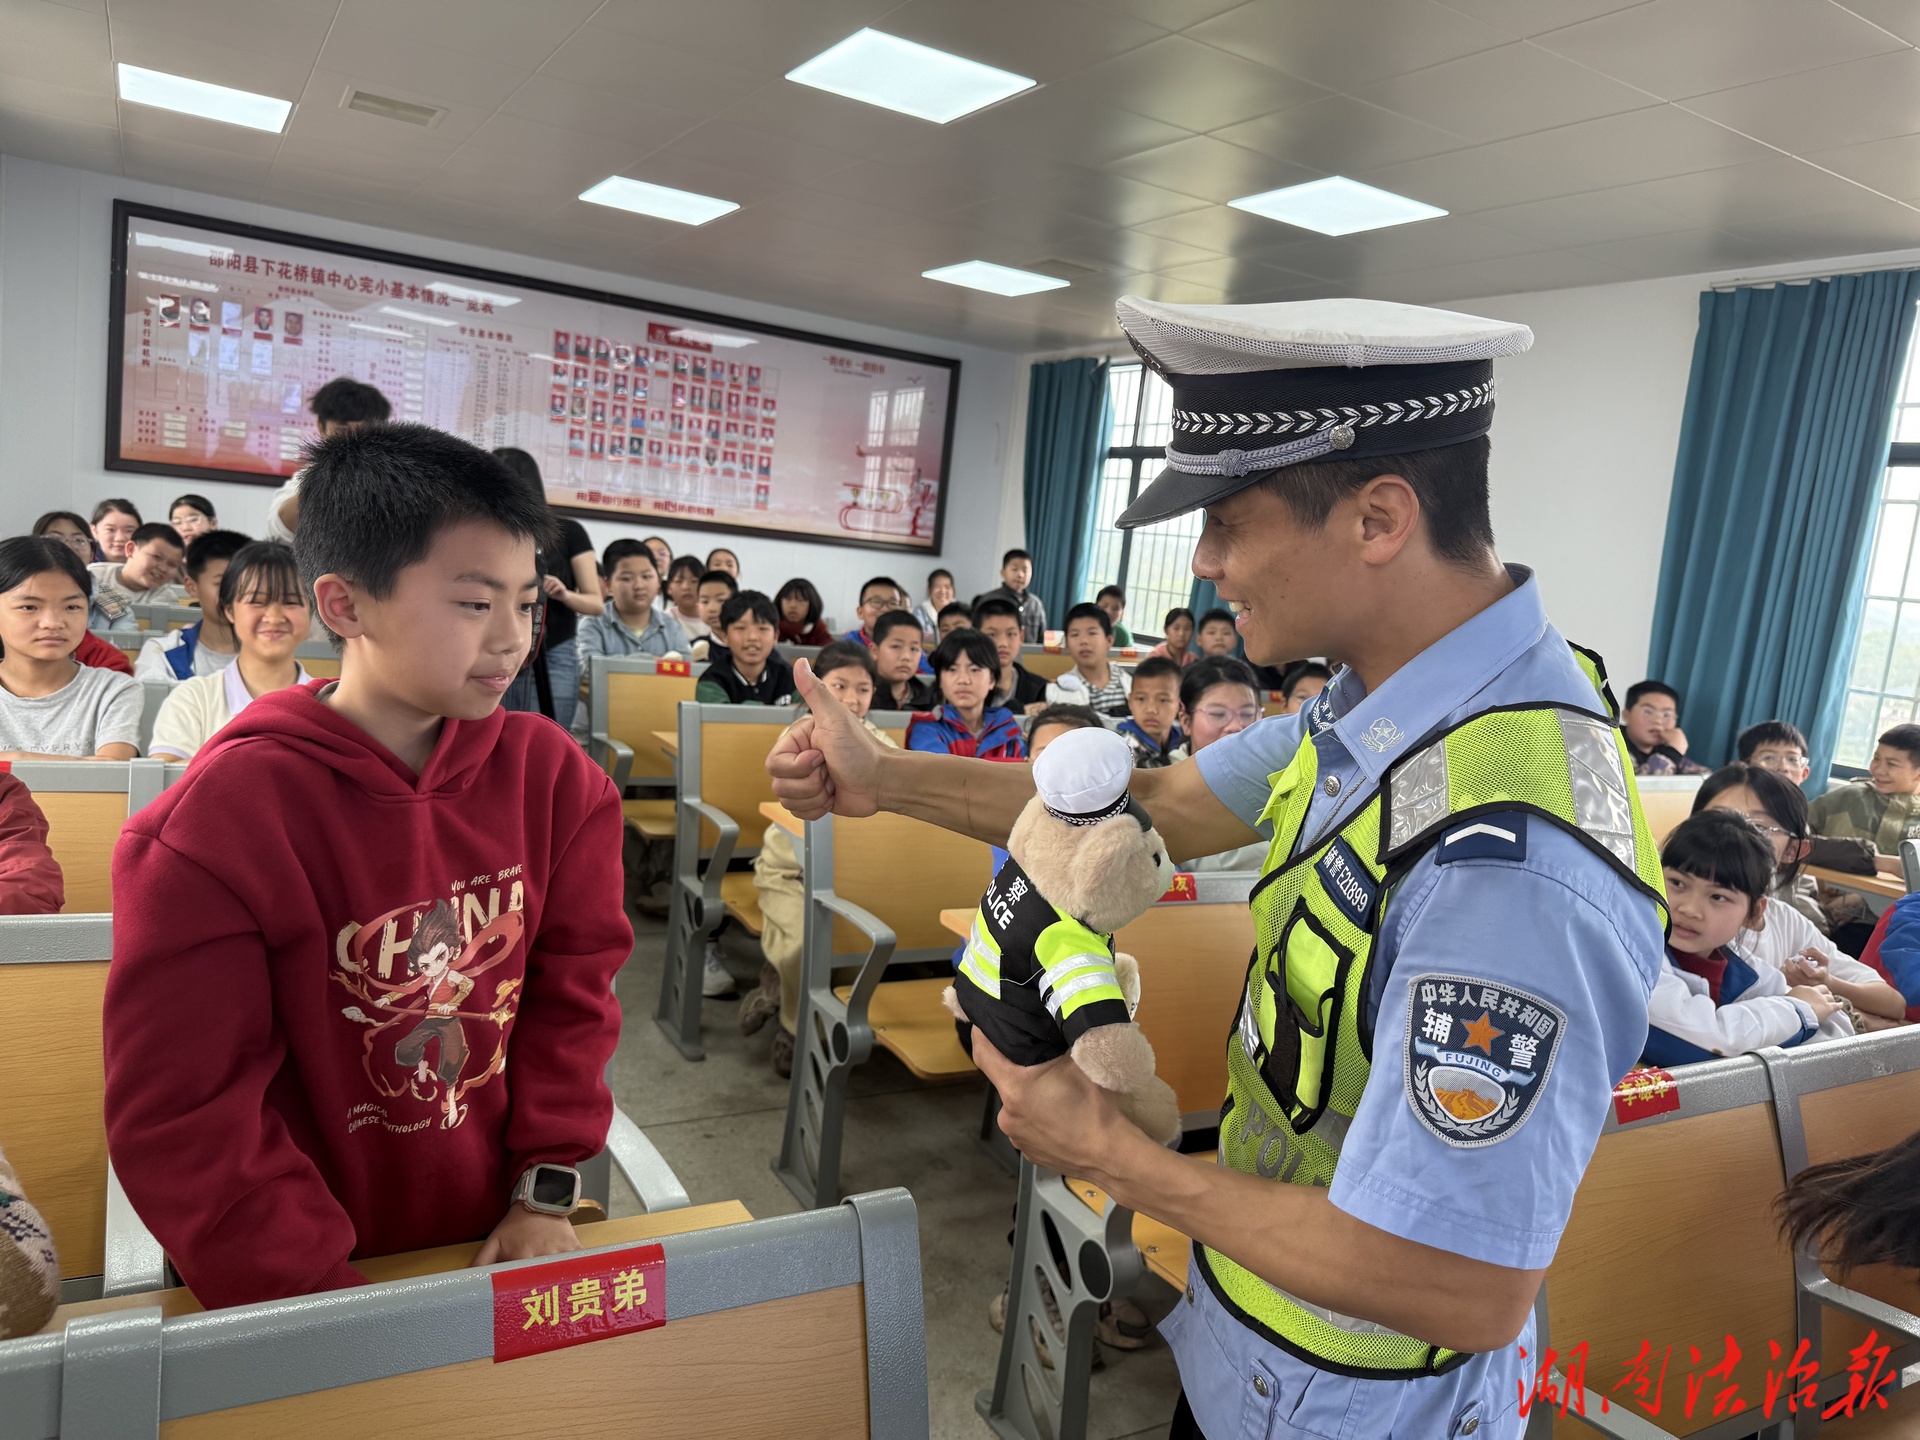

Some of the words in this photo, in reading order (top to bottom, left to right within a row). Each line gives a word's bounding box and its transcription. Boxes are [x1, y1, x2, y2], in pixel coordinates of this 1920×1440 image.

[209, 249, 495, 314] 邵阳县下花桥镇中心完小基本情况一览表
[451, 880, 466, 894] YOU
[470, 875, 491, 886] ARE
[498, 864, 523, 881] BRAVE
[986, 879, 1015, 931] OLICE
[1421, 983, 1555, 1040] 中华人民共和国
[1445, 1052, 1502, 1078] FUJING
[348, 1116, 379, 1133] CHINESE
[353, 1103, 388, 1118] MAGICAL
[522, 1268, 647, 1331] 刘贵弟
